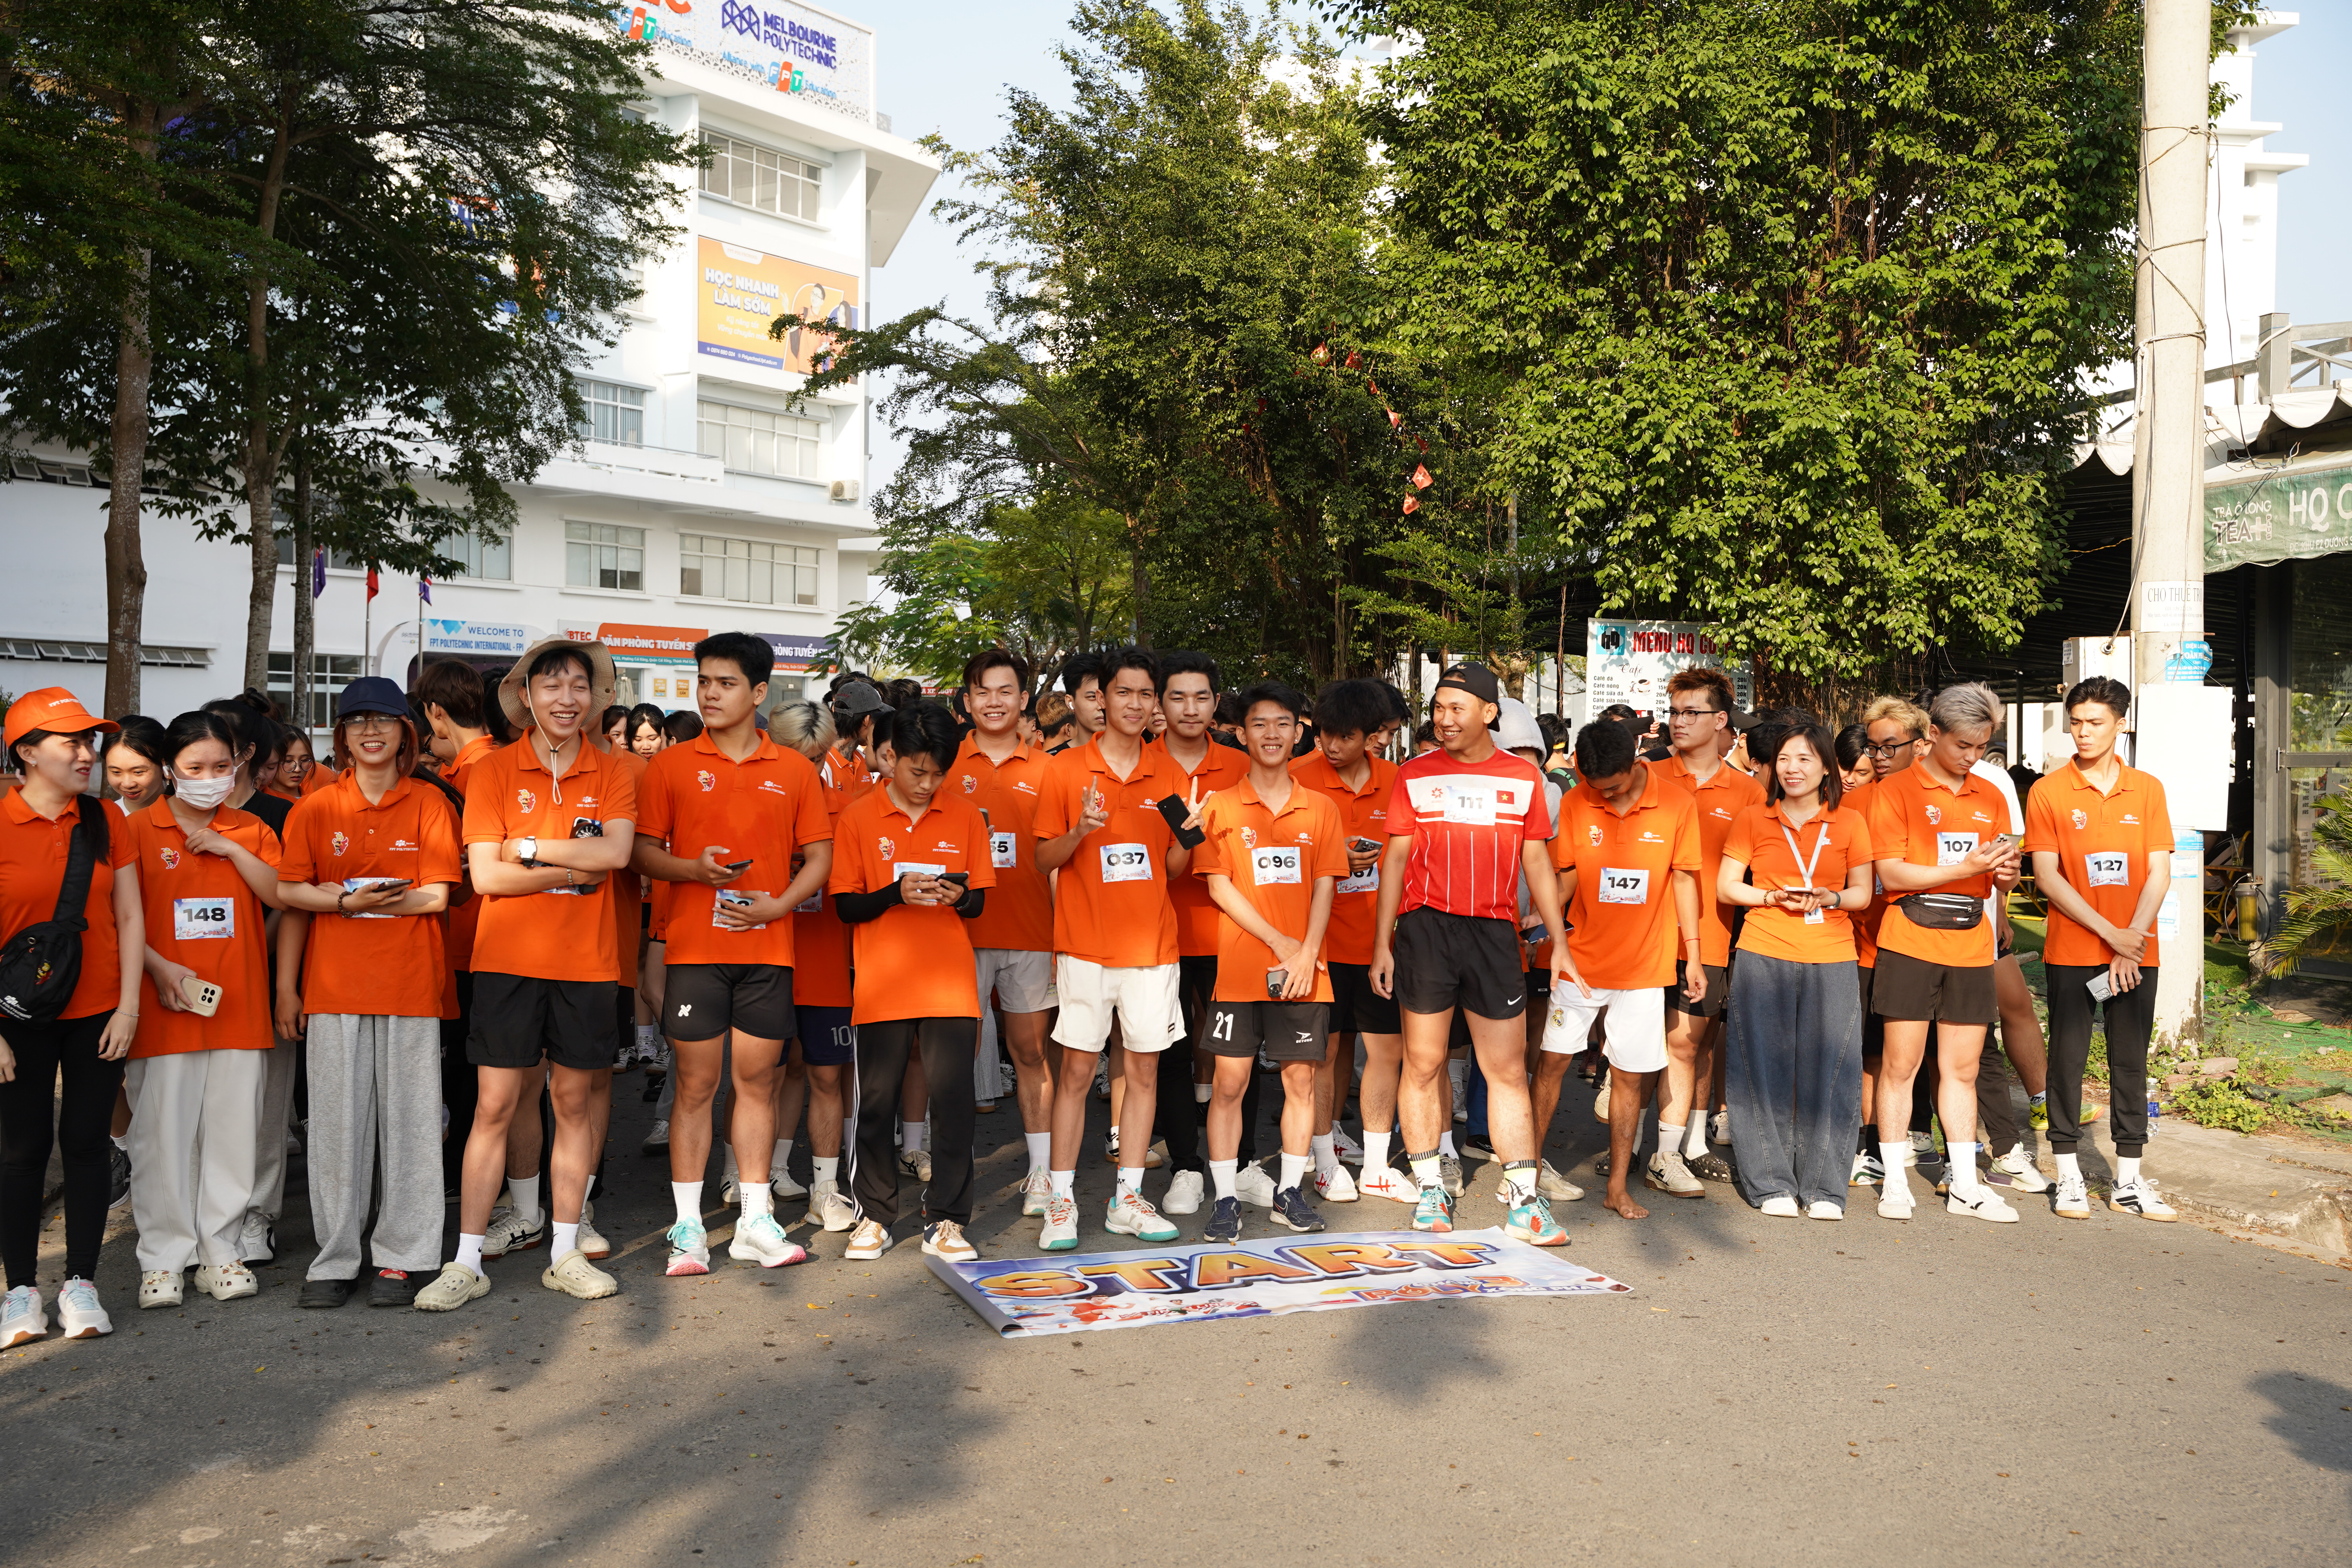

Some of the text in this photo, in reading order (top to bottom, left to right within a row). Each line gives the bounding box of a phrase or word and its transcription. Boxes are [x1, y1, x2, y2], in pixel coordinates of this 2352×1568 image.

[620, 9, 655, 37] FPT
[764, 11, 836, 53] MELBOURNE
[764, 29, 836, 69] POLYTECHNIC
[768, 63, 803, 90] FPT
[705, 267, 779, 299] HỌC NHANH
[714, 288, 771, 316] LÀM SỚM
[2213, 499, 2272, 519] TRÀ Ô LONG
[2289, 487, 2330, 532] HQ
[2301, 541, 2314, 551] KHU
[2316, 540, 2323, 549] F2
[2324, 536, 2348, 548] ĐƯỜNG
[2148, 584, 2202, 605] CHO THUÊ TRỌ
[468, 626, 510, 636] WELCOME
[568, 630, 592, 641] BTEC
[430, 639, 439, 647] FPT
[440, 639, 473, 649] POLYTECHNIC
[475, 641, 512, 651] INTERNATIONAL
[601, 634, 621, 647] VĂN
[621, 635, 655, 649] PHÒNG
[655, 637, 685, 650] TUYỂN
[772, 643, 793, 656] HÒNG
[1633, 631, 1672, 653] MENU
[1677, 632, 1695, 655] HQ
[2183, 650, 2198, 659] OÀN
[1618, 663, 1643, 677] Café
[1457, 796, 1483, 809] 111
[1944, 841, 1972, 852] 107
[1107, 852, 1145, 866] 037
[1258, 855, 1296, 869] 096
[2094, 859, 2122, 871] 127
[1608, 877, 1640, 889] 147
[183, 907, 225, 922] 148
[1213, 1011, 1234, 1041] 21
[831, 1025, 852, 1047] 10
[975, 1242, 1494, 1298] START
[1357, 1284, 1481, 1301] POLY
